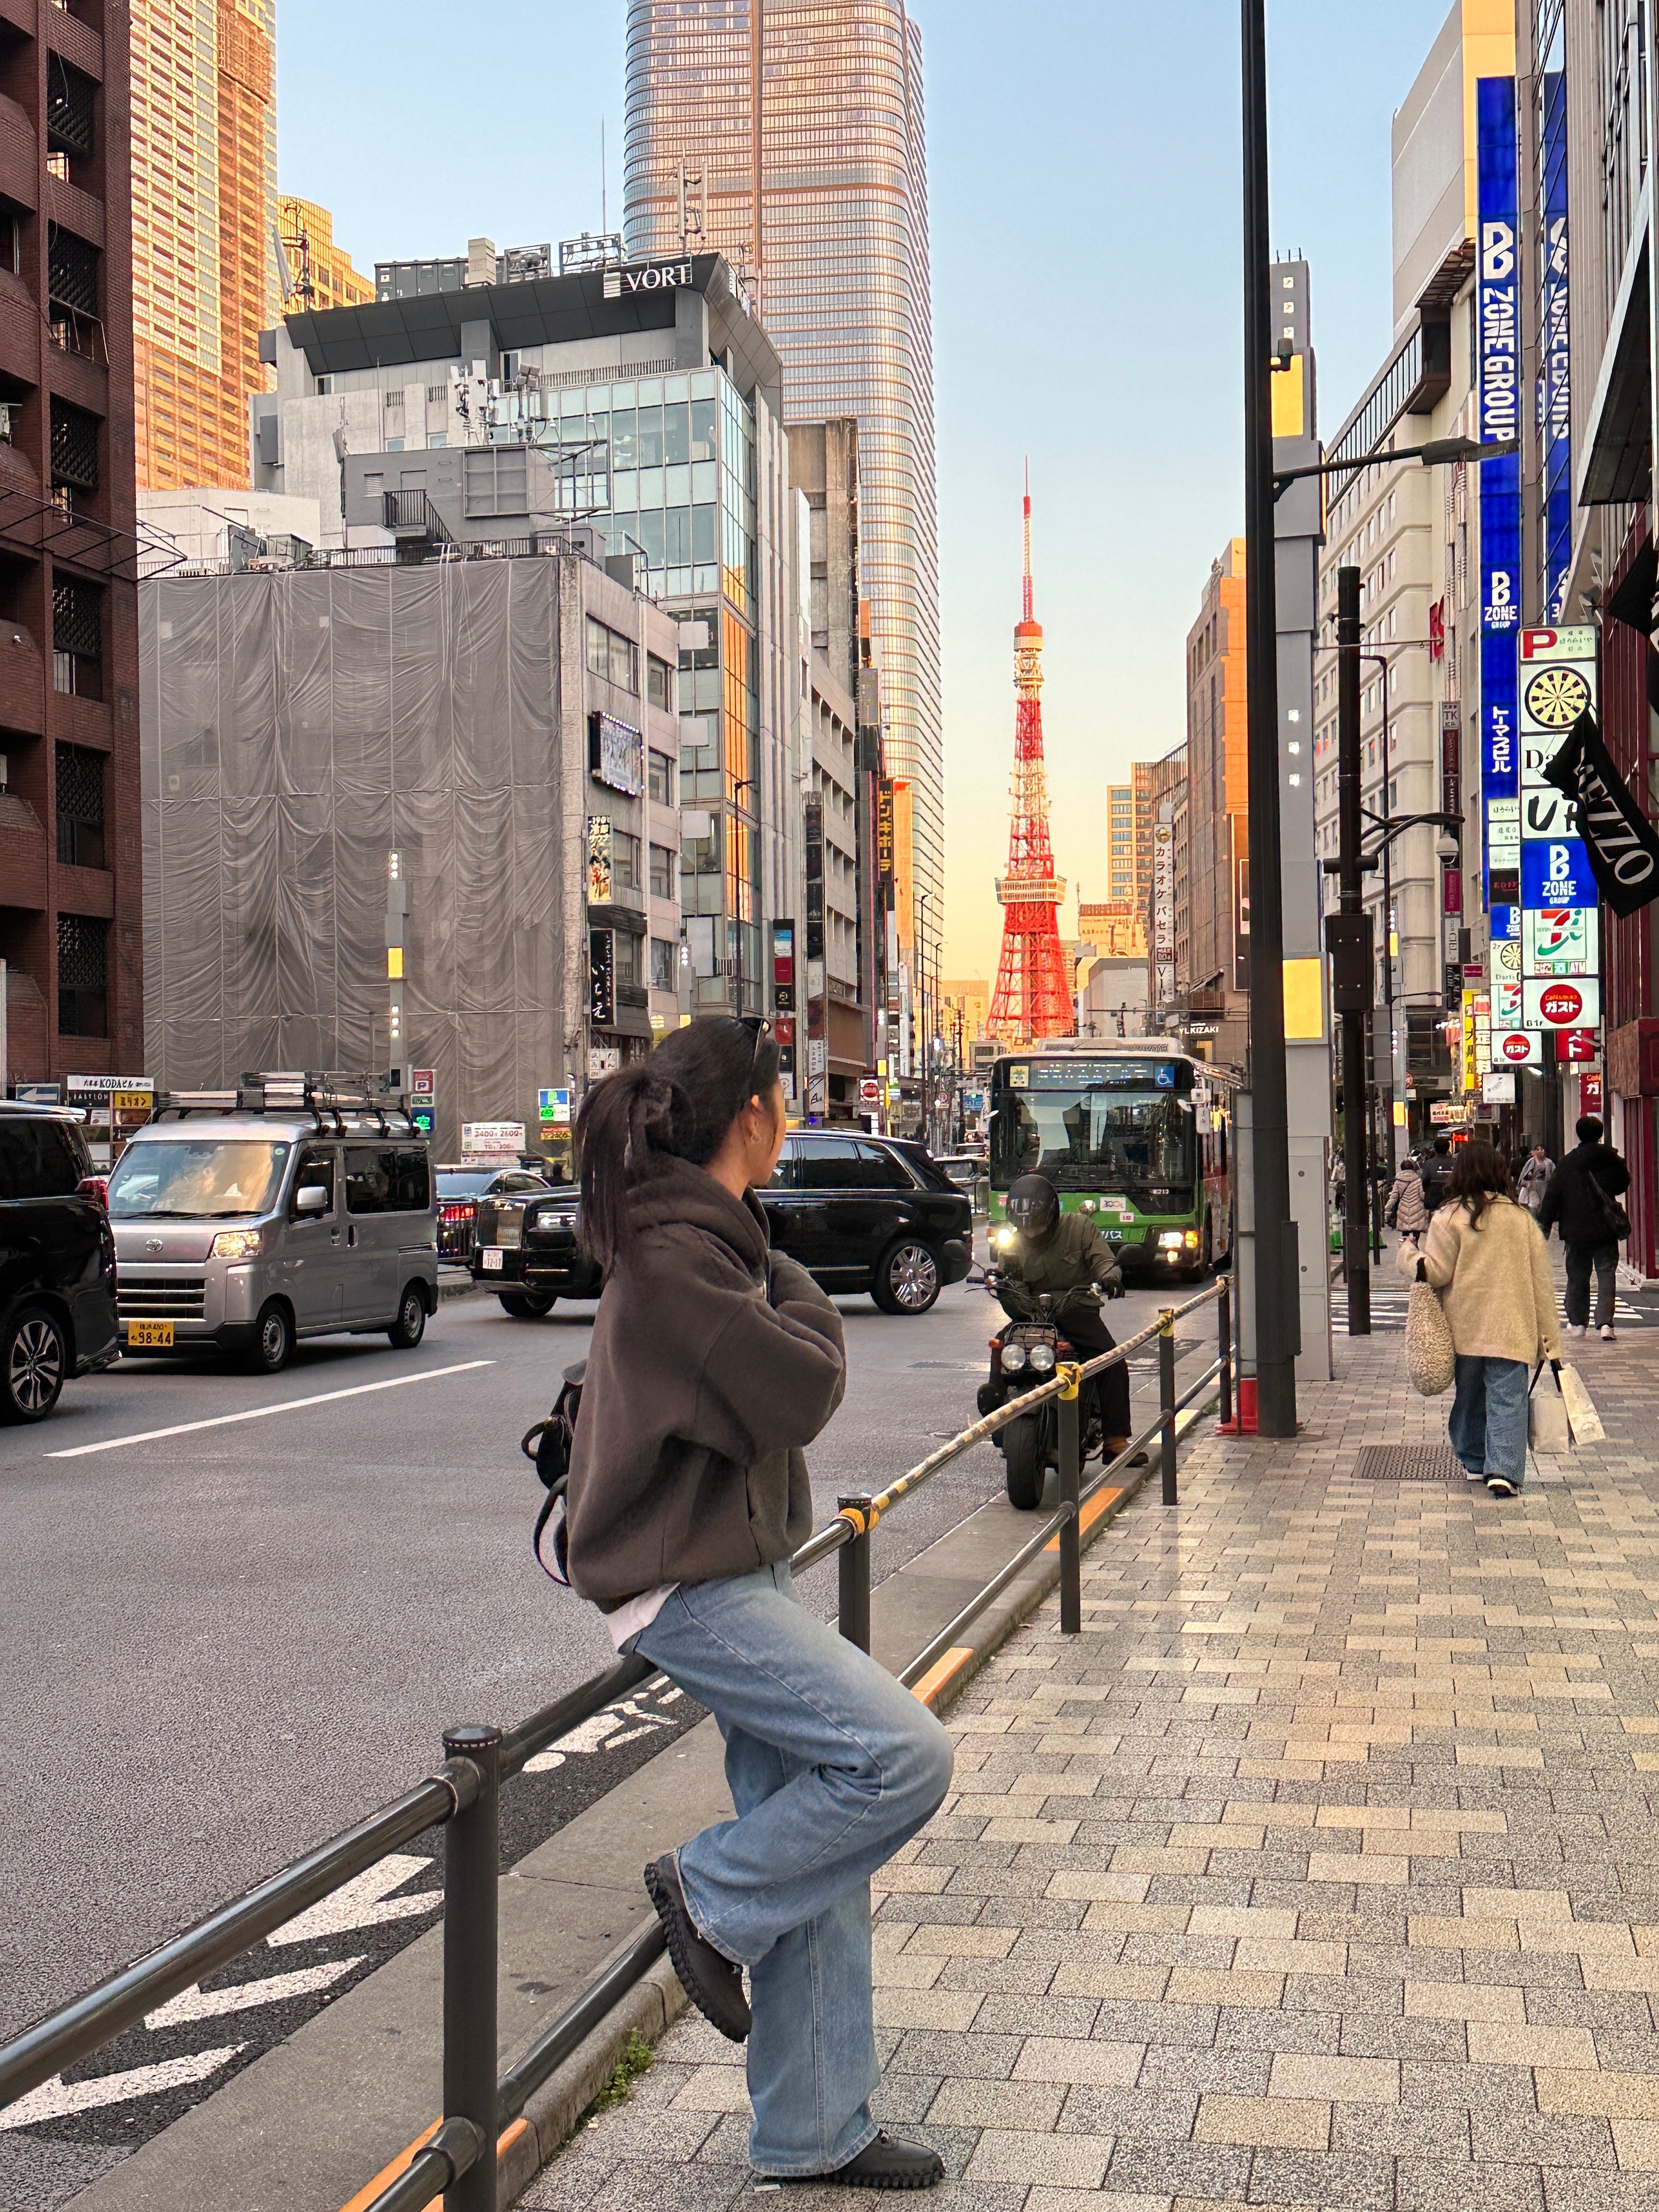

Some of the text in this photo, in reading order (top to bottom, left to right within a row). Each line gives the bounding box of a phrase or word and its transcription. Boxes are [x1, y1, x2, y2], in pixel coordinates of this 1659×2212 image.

[1483, 222, 1514, 279] B
[627, 264, 691, 291] VORT
[1492, 571, 1510, 606] B
[1485, 605, 1517, 622] ZONE
[1523, 630, 1558, 658] P
[1156, 847, 1166, 899] カラオケ
[1550, 845, 1569, 881] B
[1542, 881, 1576, 896] ZONE
[1545, 1001, 1579, 1013] ガスト
[1506, 1045, 1528, 1053] ガスト
[138, 1329, 171, 1344] 98-44
